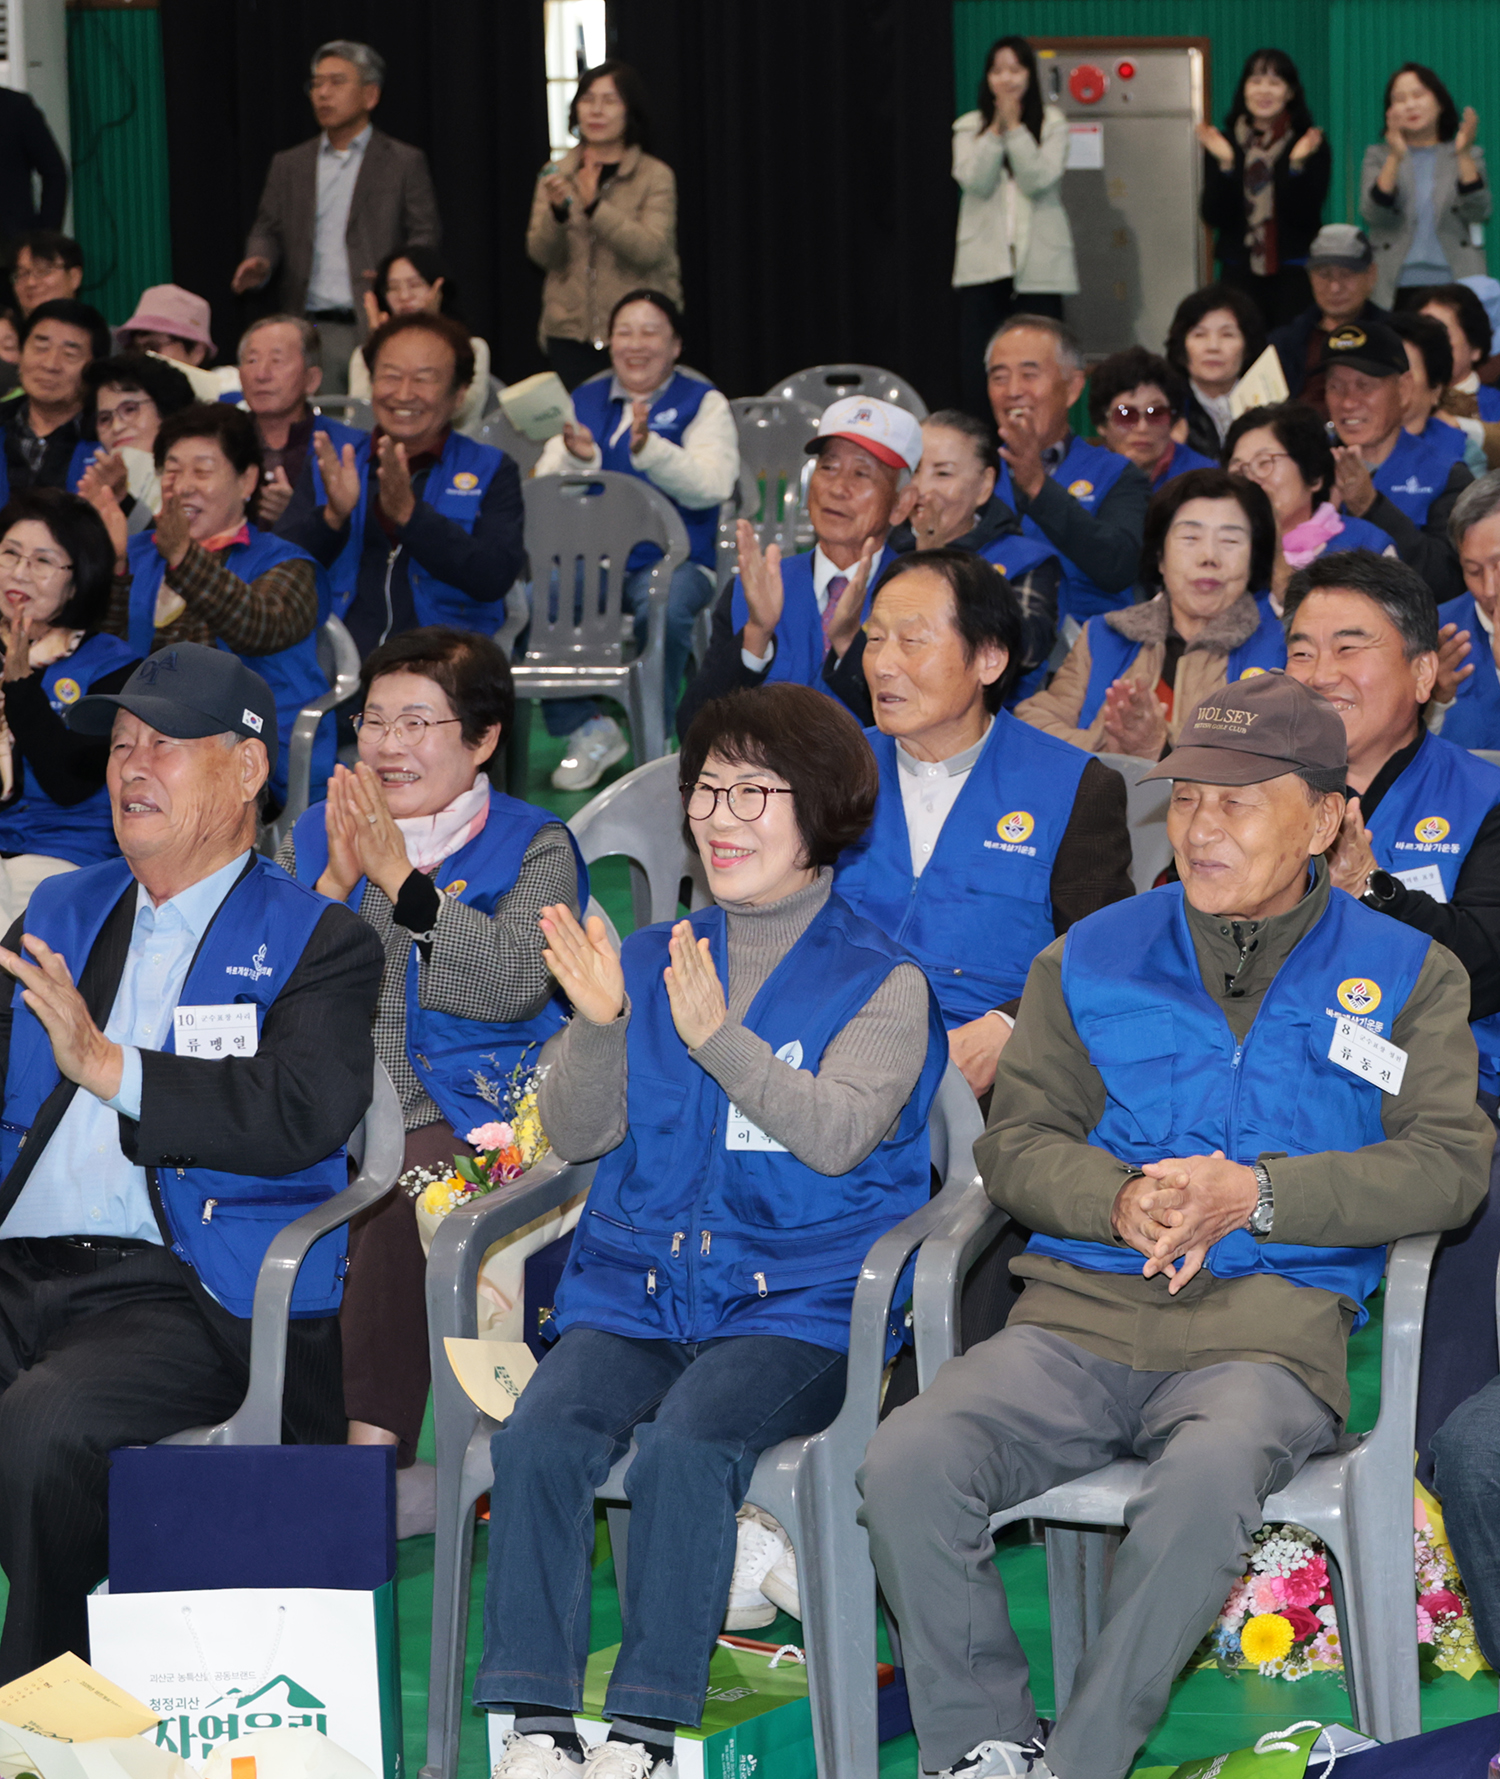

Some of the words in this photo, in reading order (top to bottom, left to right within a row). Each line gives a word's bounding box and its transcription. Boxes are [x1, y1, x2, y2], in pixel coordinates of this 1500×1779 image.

[1228, 724, 1247, 735] CLUB
[983, 839, 1037, 857] 바르게살기운동
[1394, 841, 1461, 854] 바르게살기운동
[178, 1013, 195, 1027] 10
[1341, 1023, 1351, 1036] 8
[149, 1673, 175, 1683] 괴산군
[214, 1671, 257, 1681] 공동브랜드
[149, 1696, 200, 1711] 청정괴산
